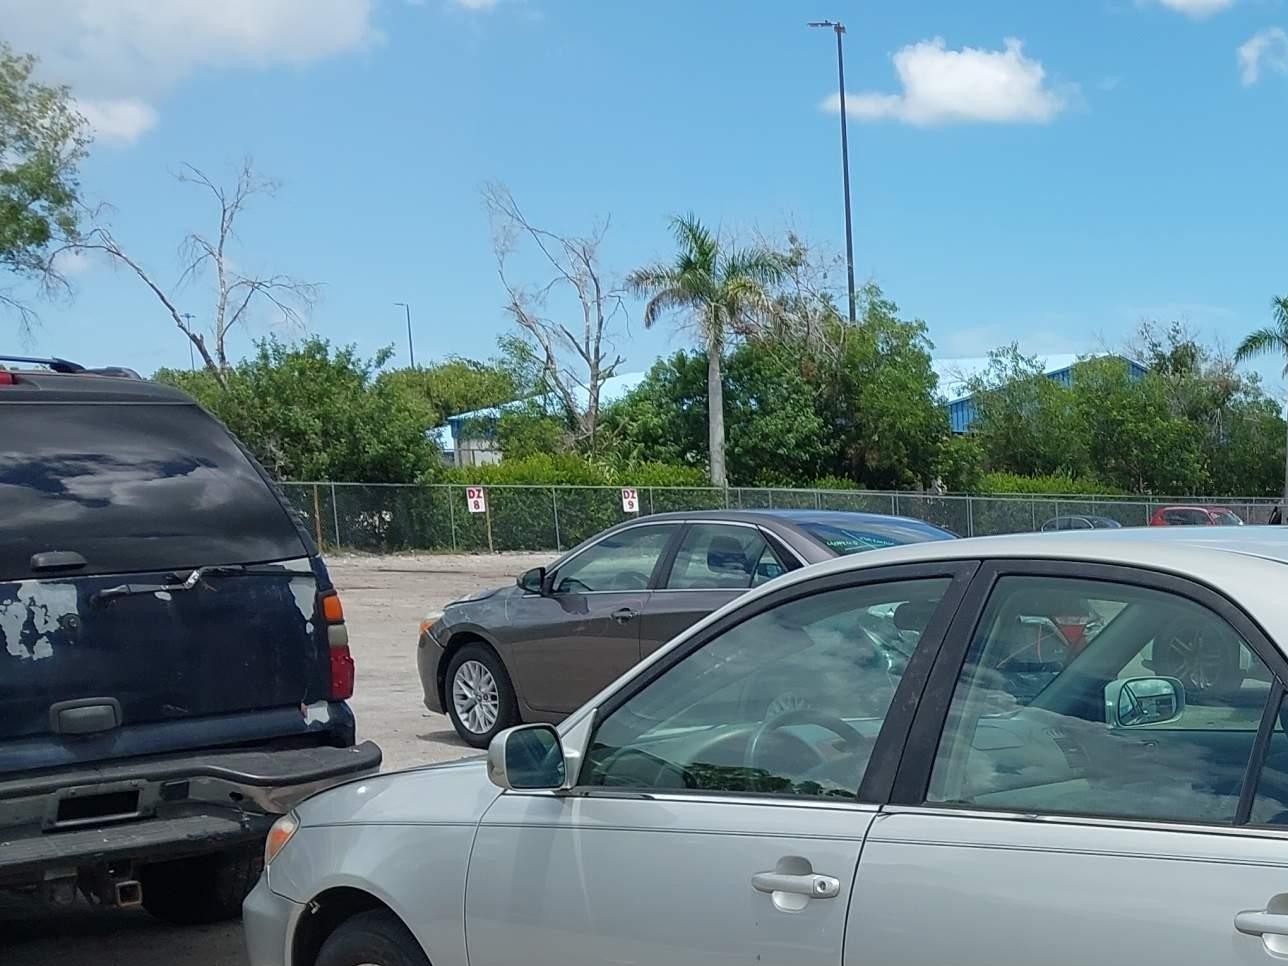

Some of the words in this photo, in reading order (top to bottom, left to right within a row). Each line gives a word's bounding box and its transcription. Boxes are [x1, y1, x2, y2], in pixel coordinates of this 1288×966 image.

[468, 489, 482, 499] DZ
[623, 490, 636, 499] DZ
[473, 500, 480, 510] 8
[628, 500, 634, 510] 9
